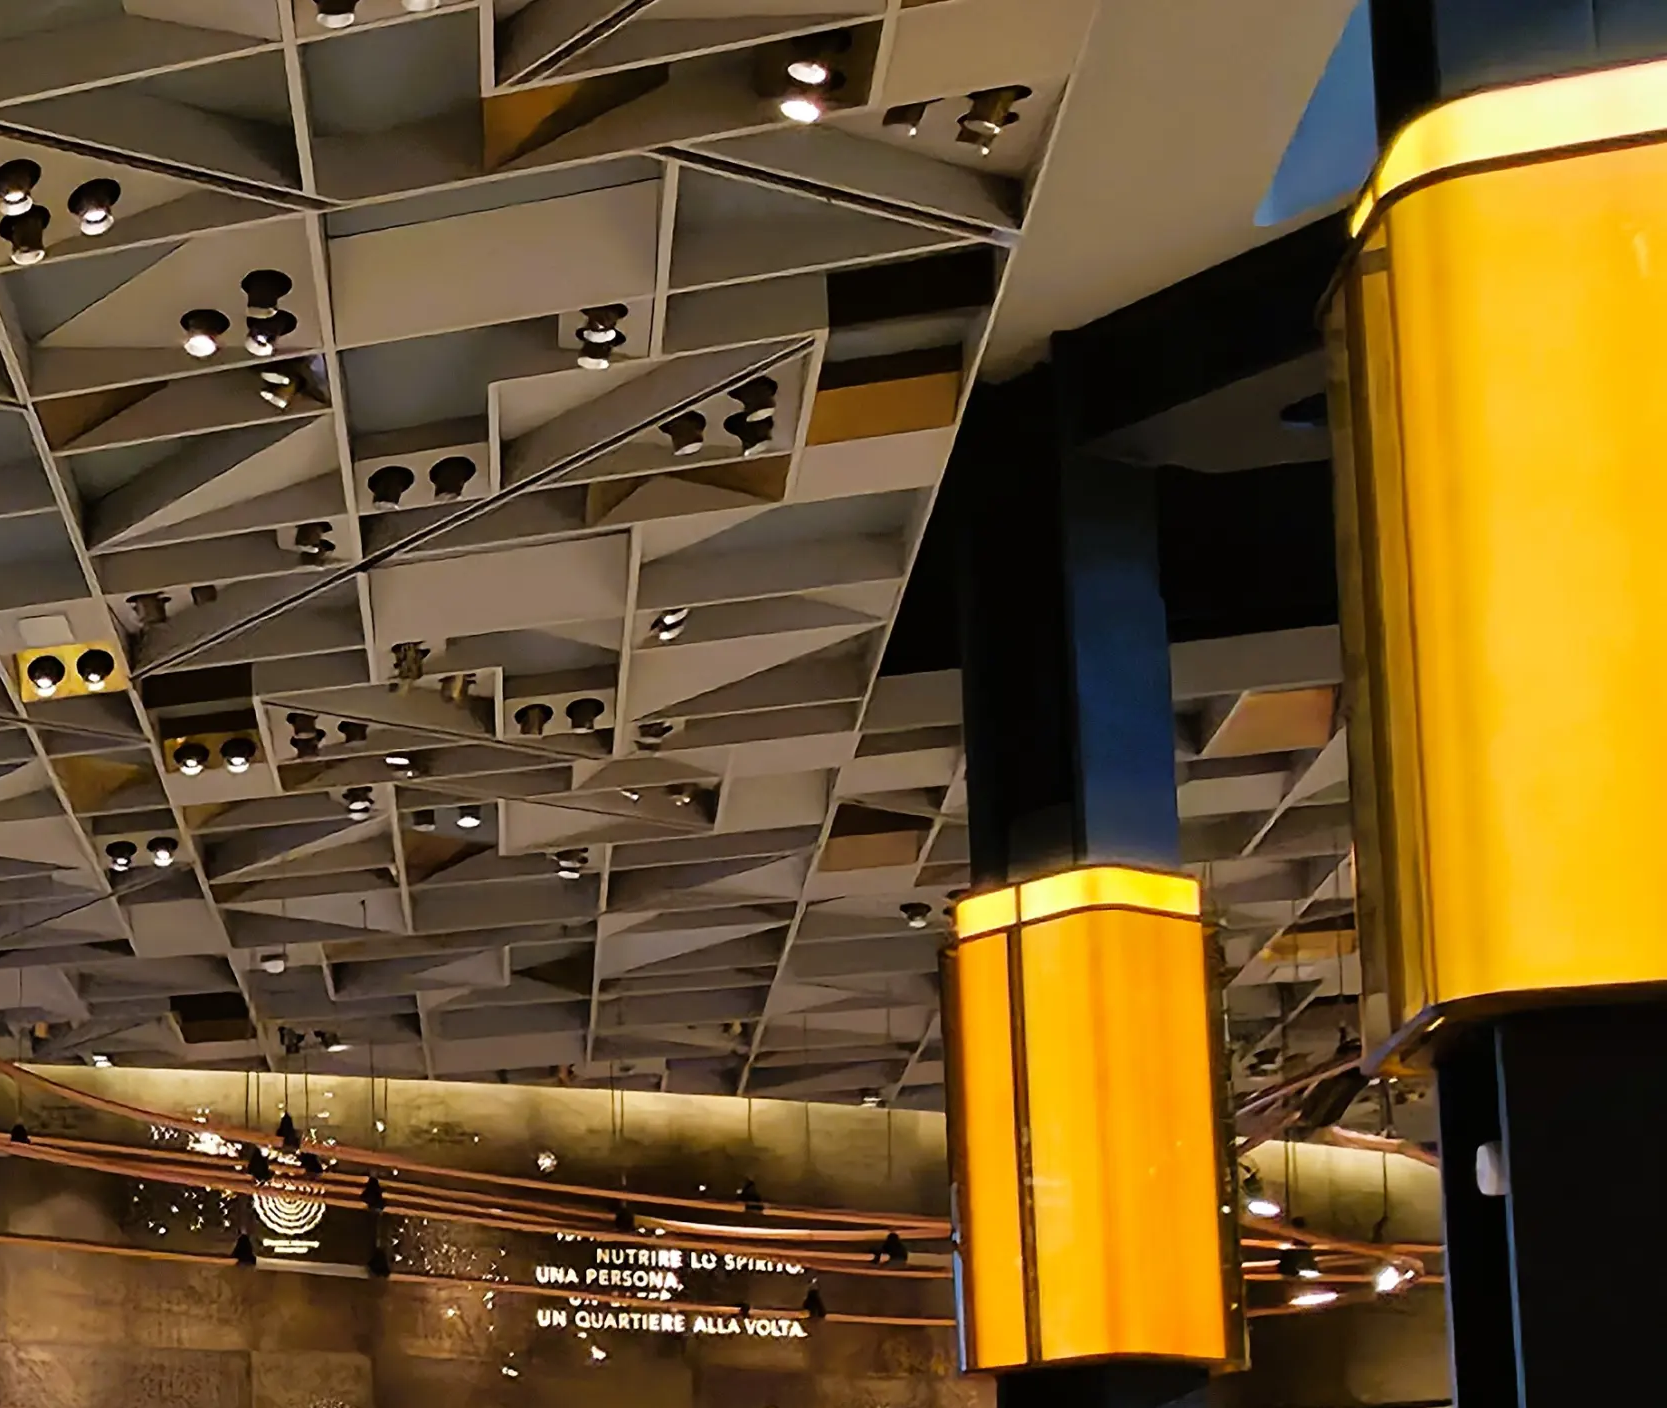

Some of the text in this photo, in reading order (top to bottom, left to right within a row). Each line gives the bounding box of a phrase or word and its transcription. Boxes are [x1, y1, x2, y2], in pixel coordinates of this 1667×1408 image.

[596, 1248, 682, 1269] NUTRIRE
[691, 1251, 718, 1270] LO
[535, 1265, 685, 1291] UNA PERSONA,
[536, 1309, 567, 1328] UN
[574, 1310, 686, 1333] QUARTIERE
[693, 1316, 741, 1335] ALLA
